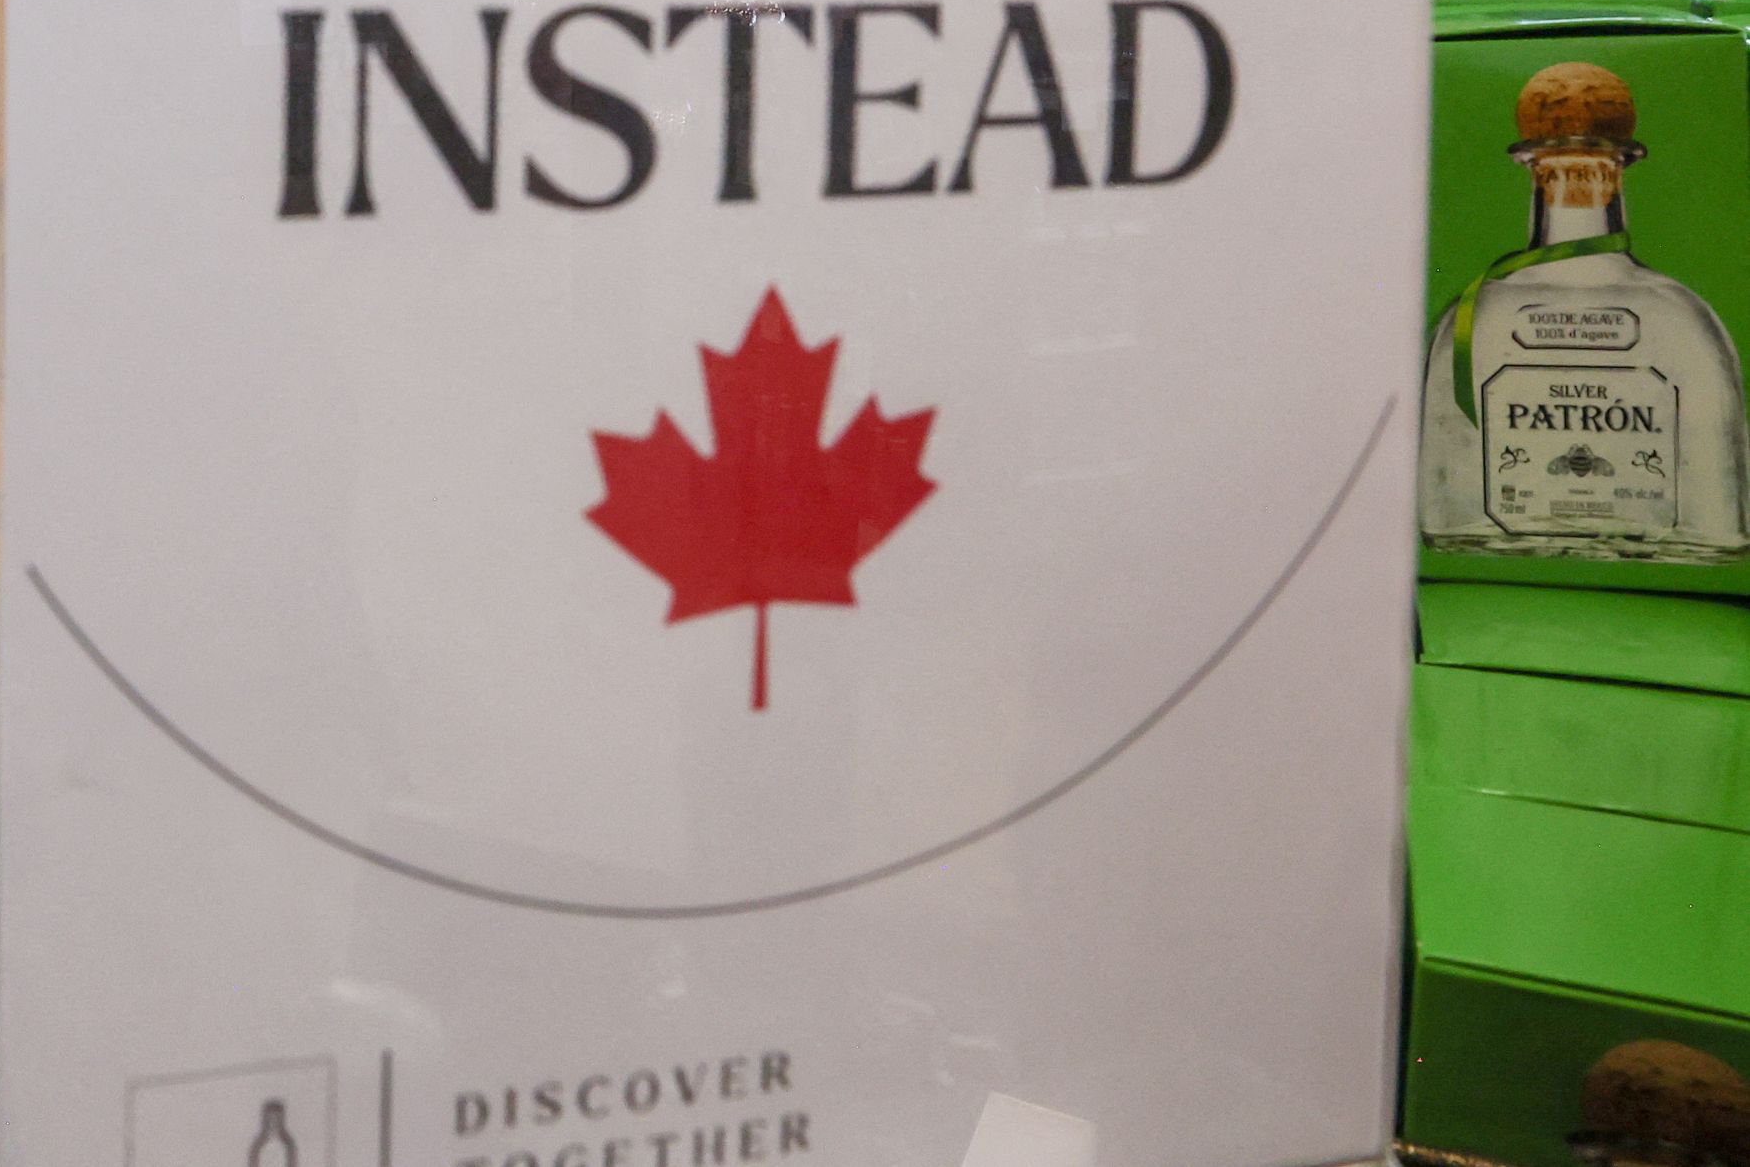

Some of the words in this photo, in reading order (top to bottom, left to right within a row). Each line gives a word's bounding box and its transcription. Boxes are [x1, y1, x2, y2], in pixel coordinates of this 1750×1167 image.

[1579, 313, 1625, 326] AGAVE
[1549, 384, 1608, 400] SILVER
[454, 1049, 793, 1137] DISCOVER
